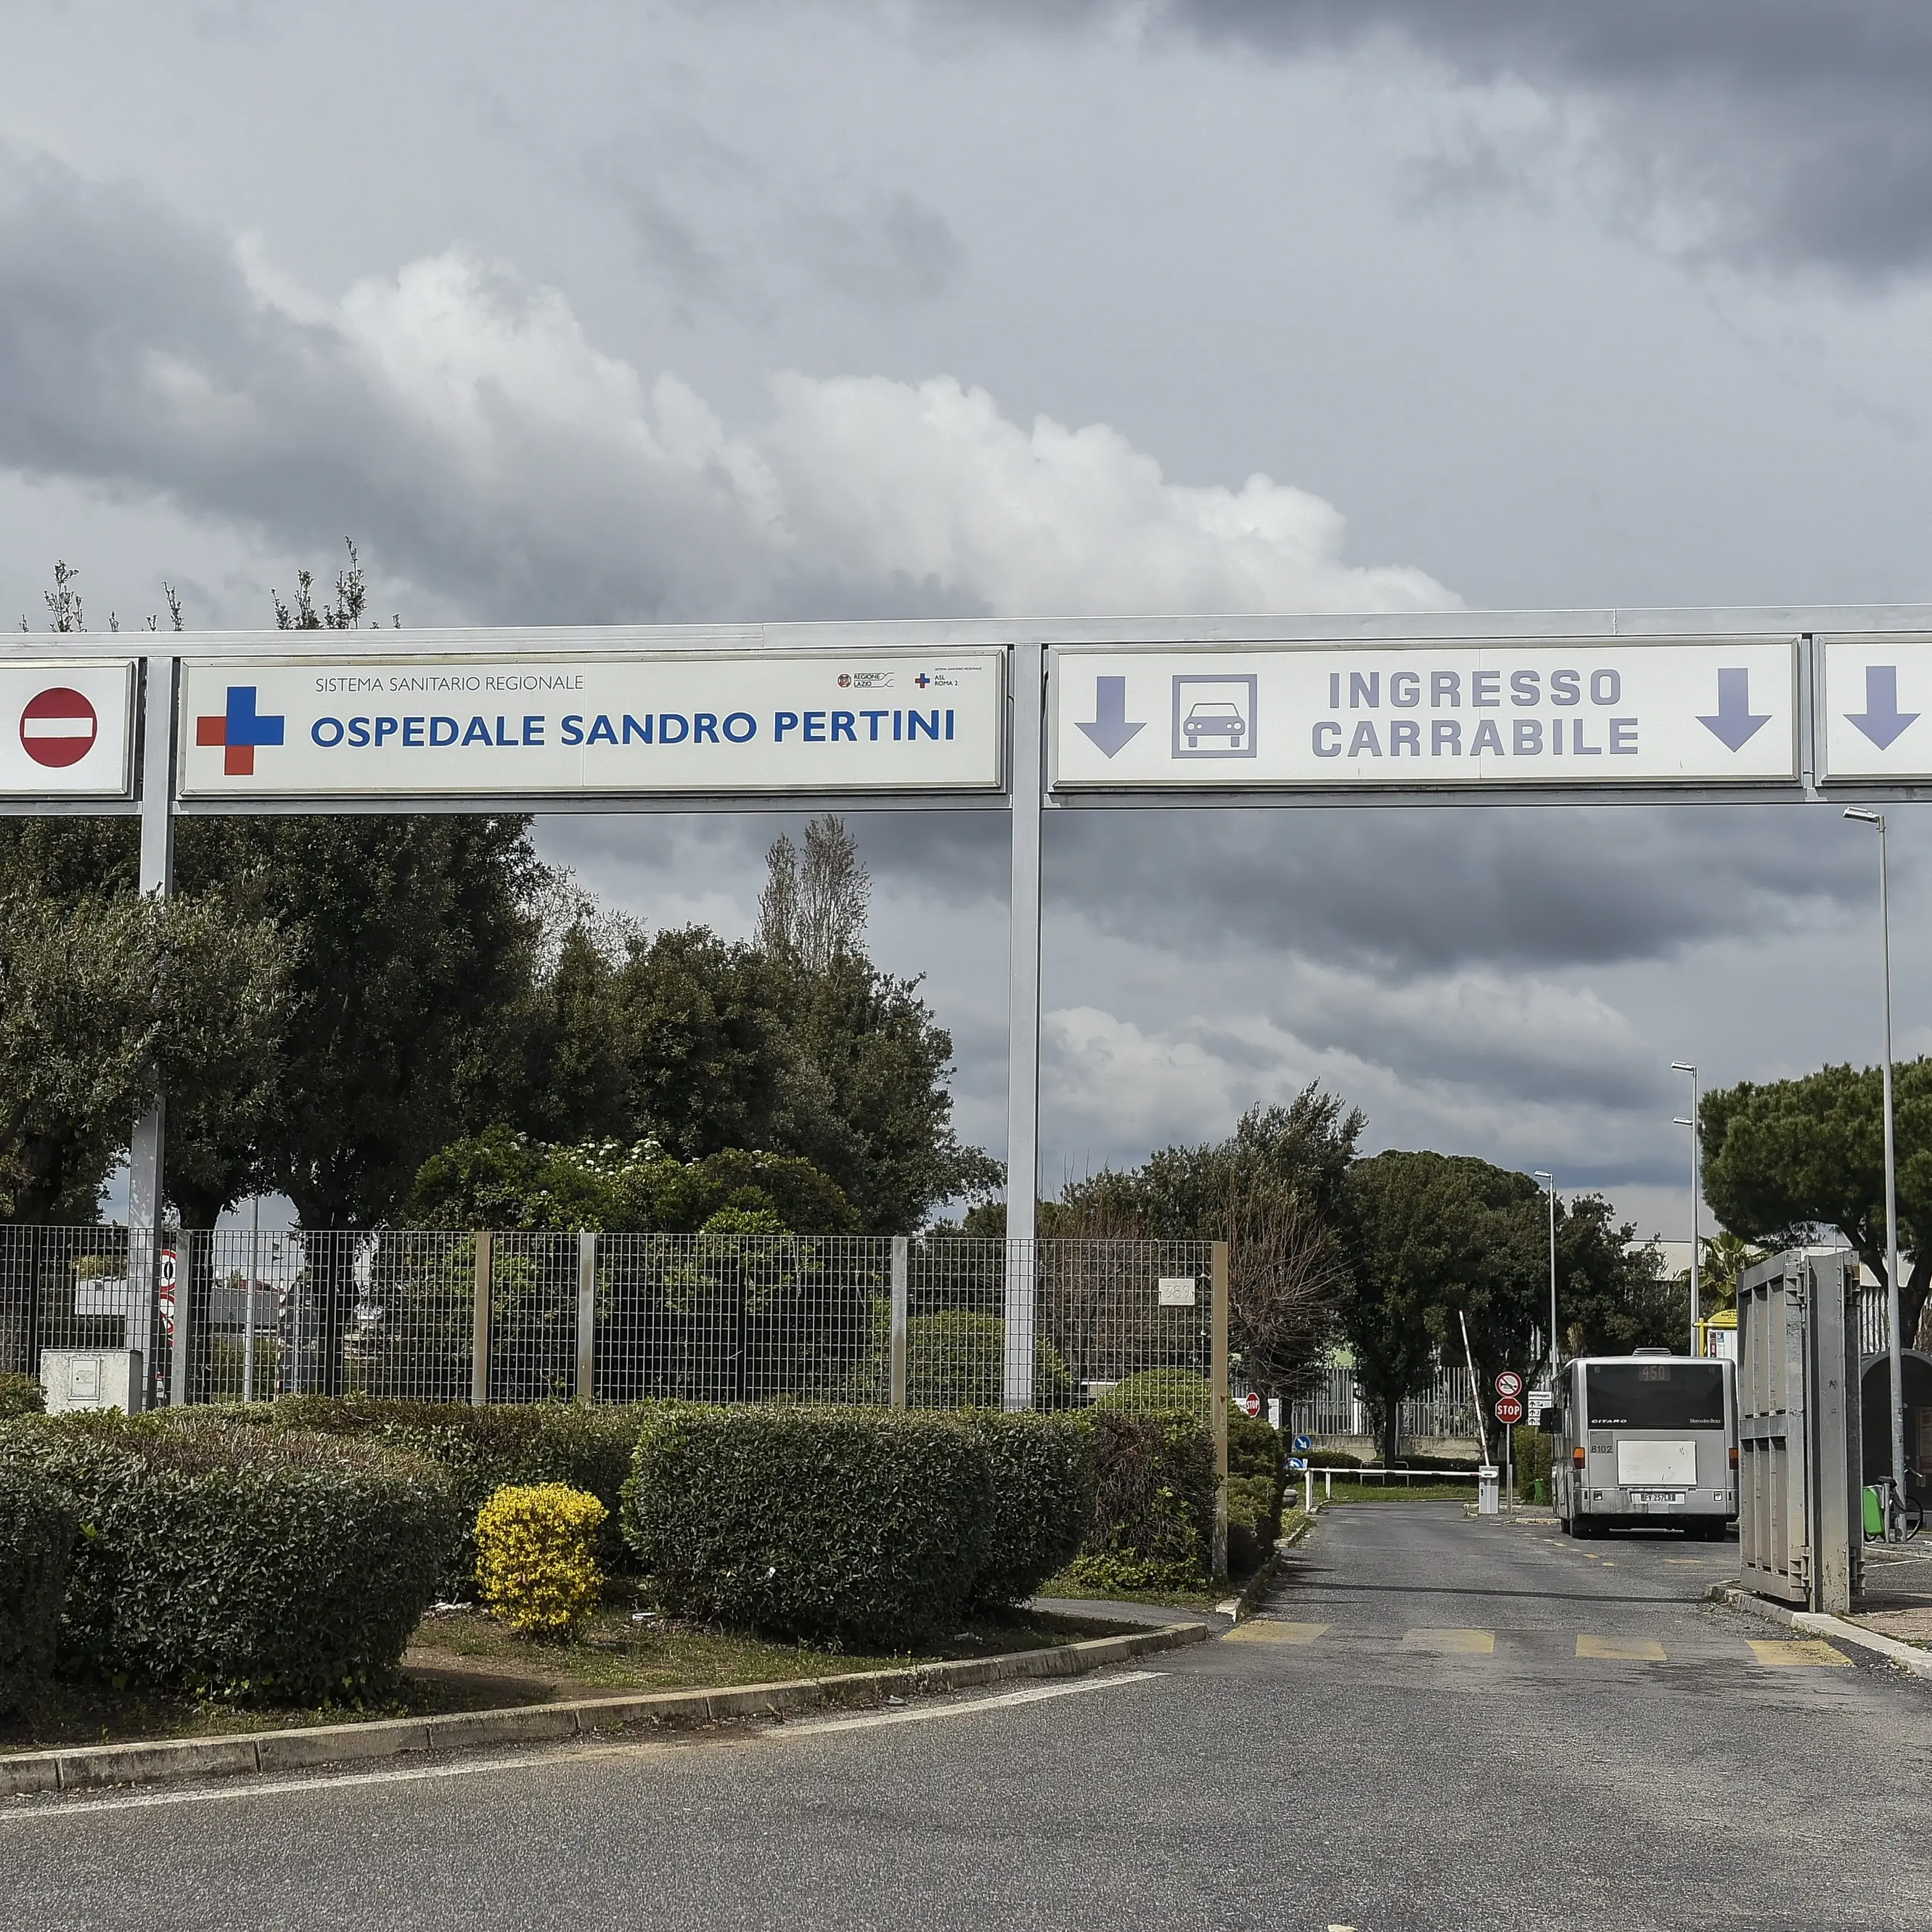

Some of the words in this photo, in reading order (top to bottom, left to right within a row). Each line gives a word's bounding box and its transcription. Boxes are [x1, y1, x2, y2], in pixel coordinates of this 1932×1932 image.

[315, 677, 383, 692] SISTEMA
[389, 676, 480, 692] SANITARIO
[486, 675, 584, 691] REGIONALE
[1329, 668, 1621, 709] INGRESSO
[311, 715, 546, 748] OSPEDALE
[561, 712, 758, 746] SANDRO
[774, 709, 954, 742] PERTINI
[1311, 717, 1639, 757] CARRABILE
[1163, 1285, 1190, 1298] 389
[1246, 1400, 1259, 1409] STOP
[1497, 1404, 1520, 1416] STOP
